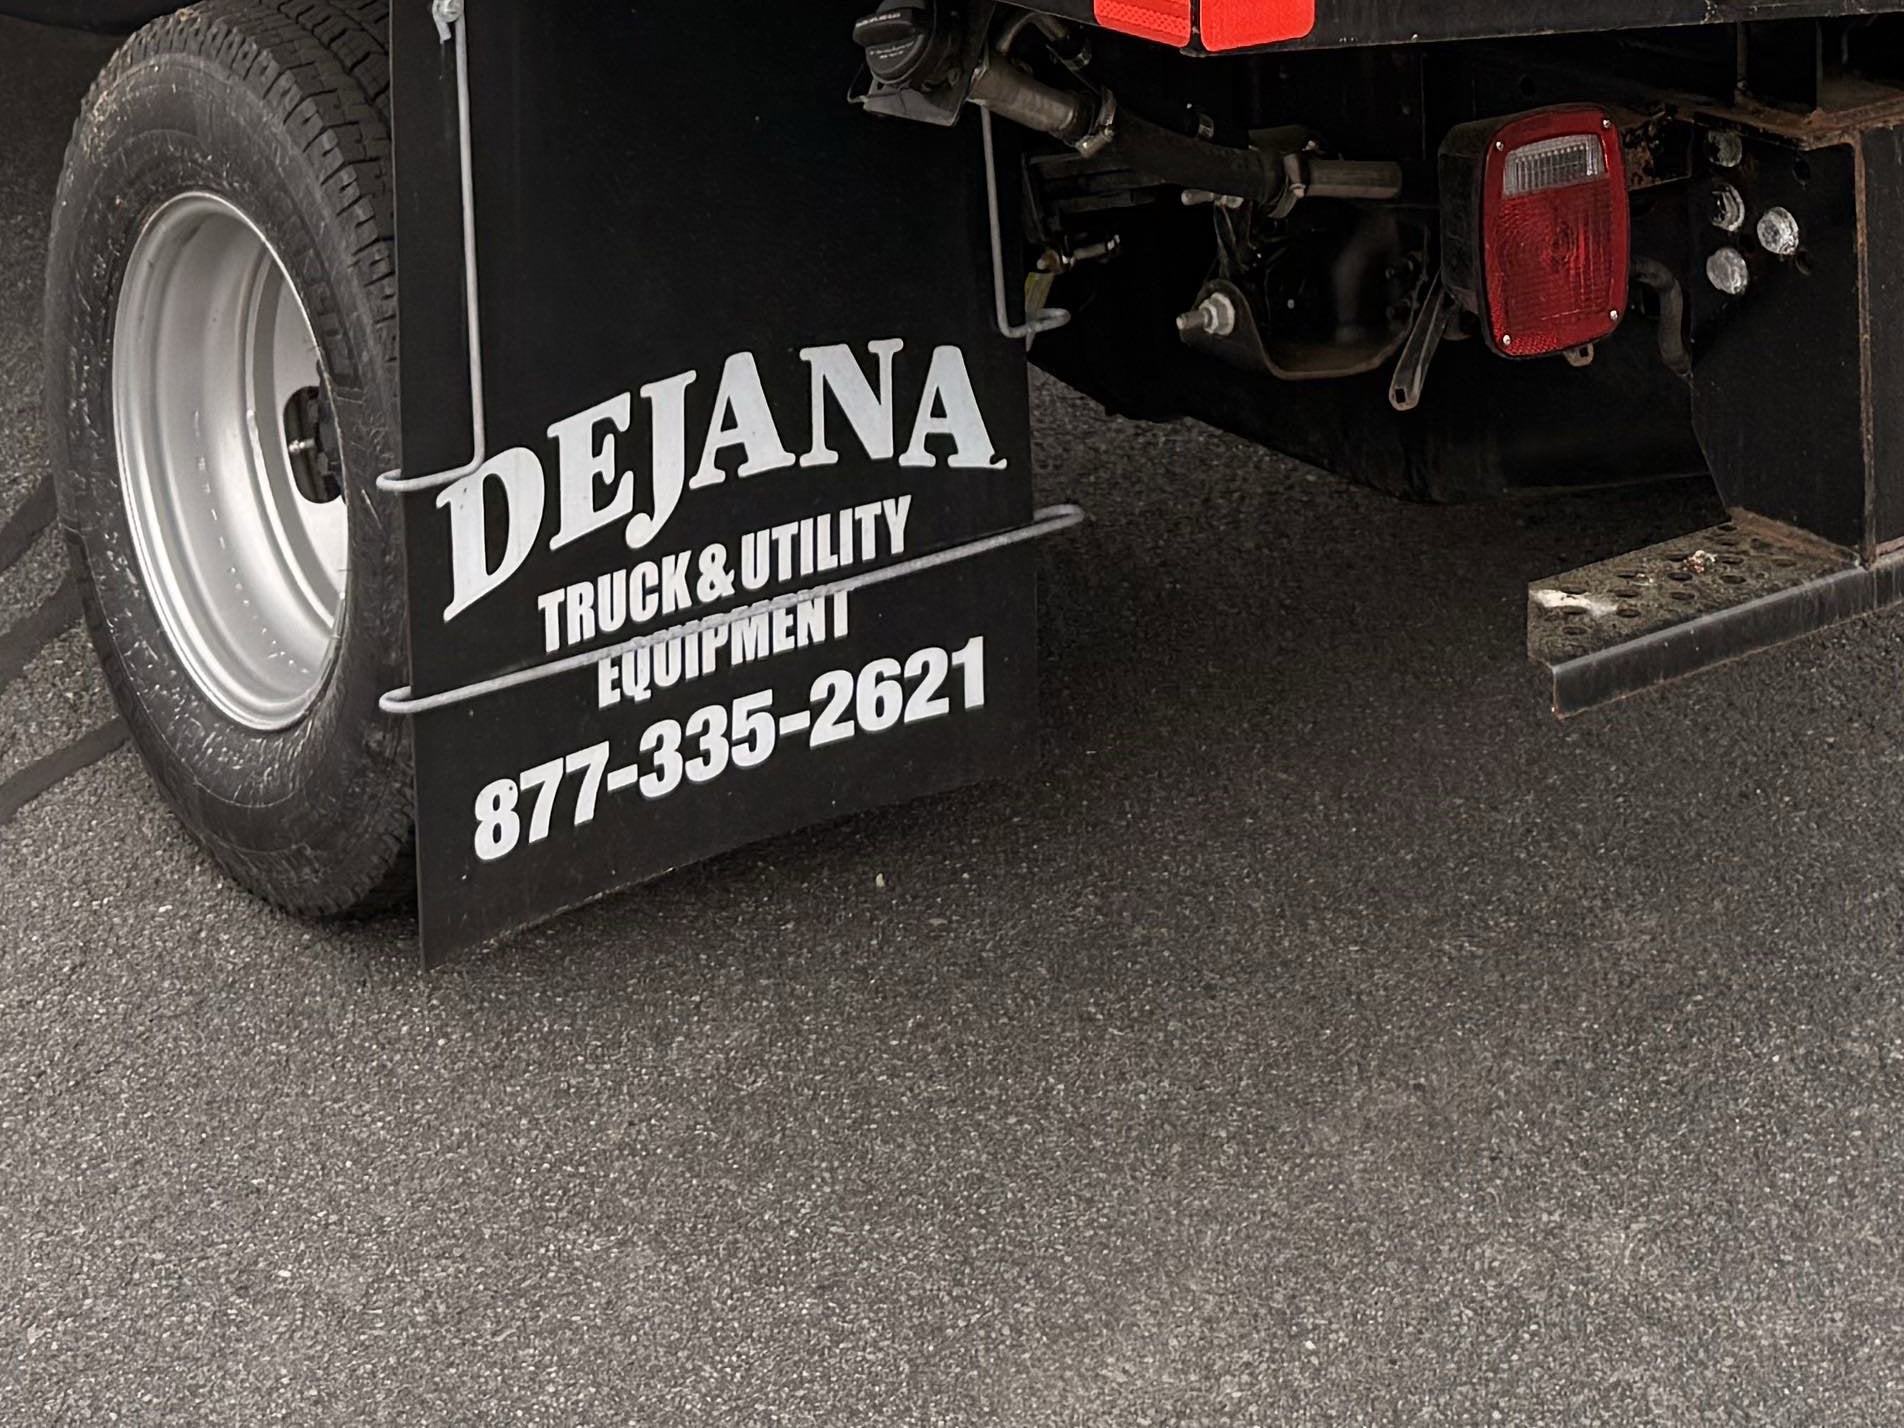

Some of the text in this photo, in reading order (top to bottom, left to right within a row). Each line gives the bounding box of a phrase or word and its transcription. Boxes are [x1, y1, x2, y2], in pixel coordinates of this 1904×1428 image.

[435, 337, 1008, 624] DEJANA
[537, 494, 912, 654] TRUCK & UTILITY
[598, 587, 856, 709] EQUIPMENT
[473, 635, 987, 861] 877-335-2621
